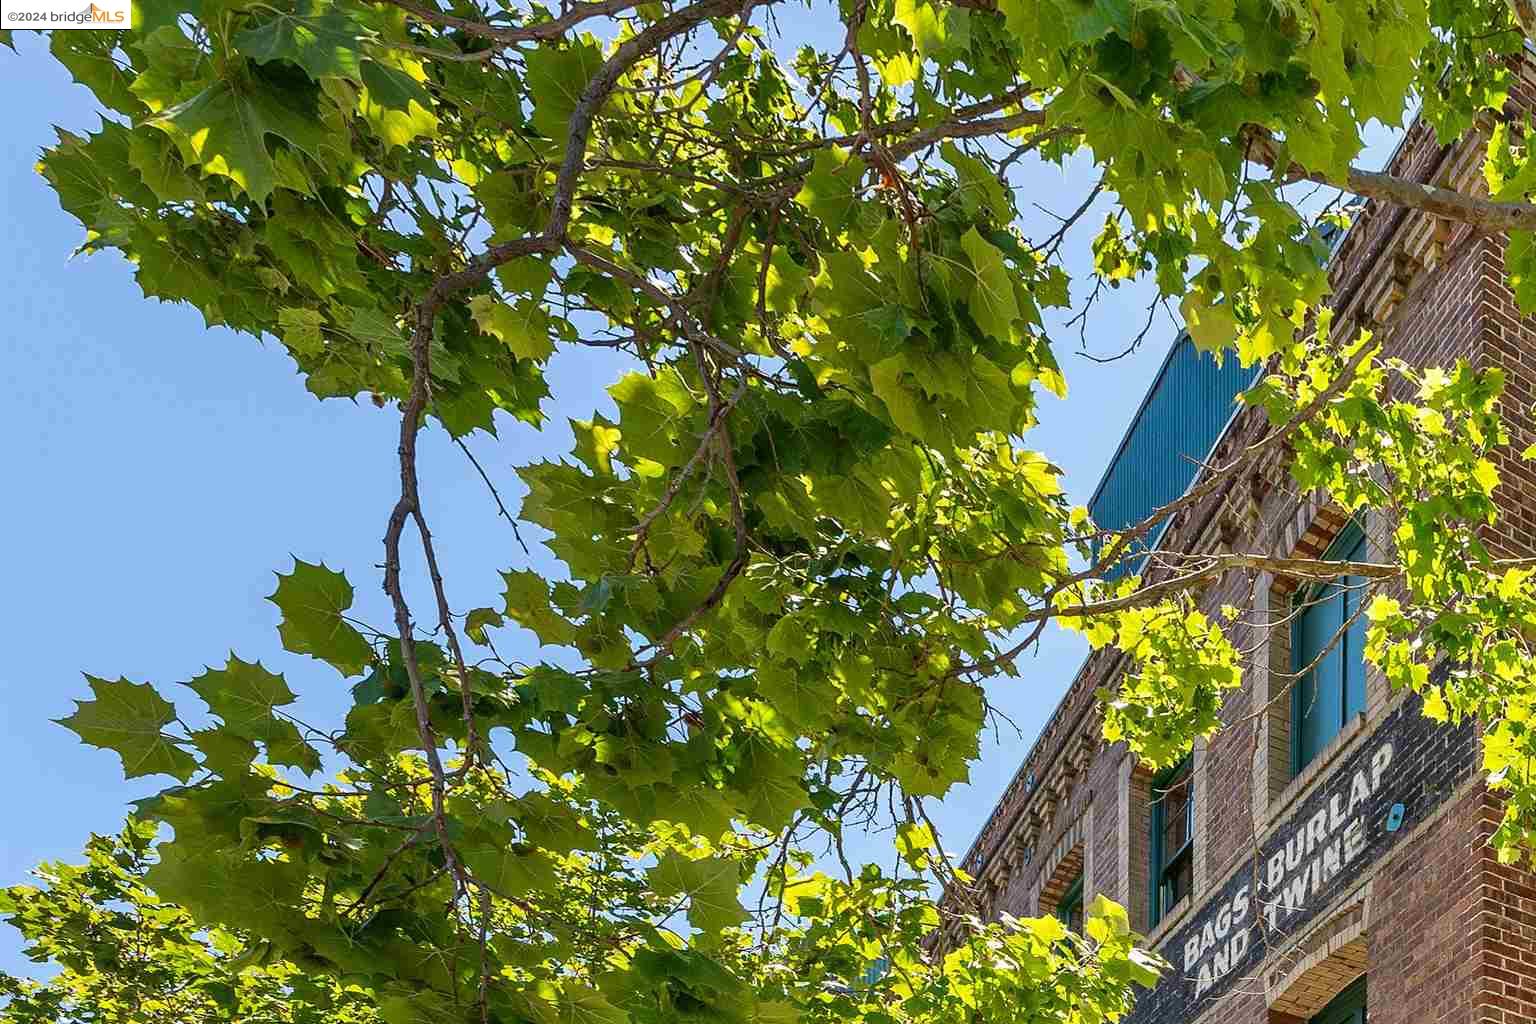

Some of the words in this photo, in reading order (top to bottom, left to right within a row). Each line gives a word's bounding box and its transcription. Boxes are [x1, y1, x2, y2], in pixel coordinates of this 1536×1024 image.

[1184, 885, 1251, 972] BAGS
[1267, 743, 1392, 891] BURLAP
[1195, 928, 1250, 999] AND
[1264, 815, 1366, 931] TWINE
